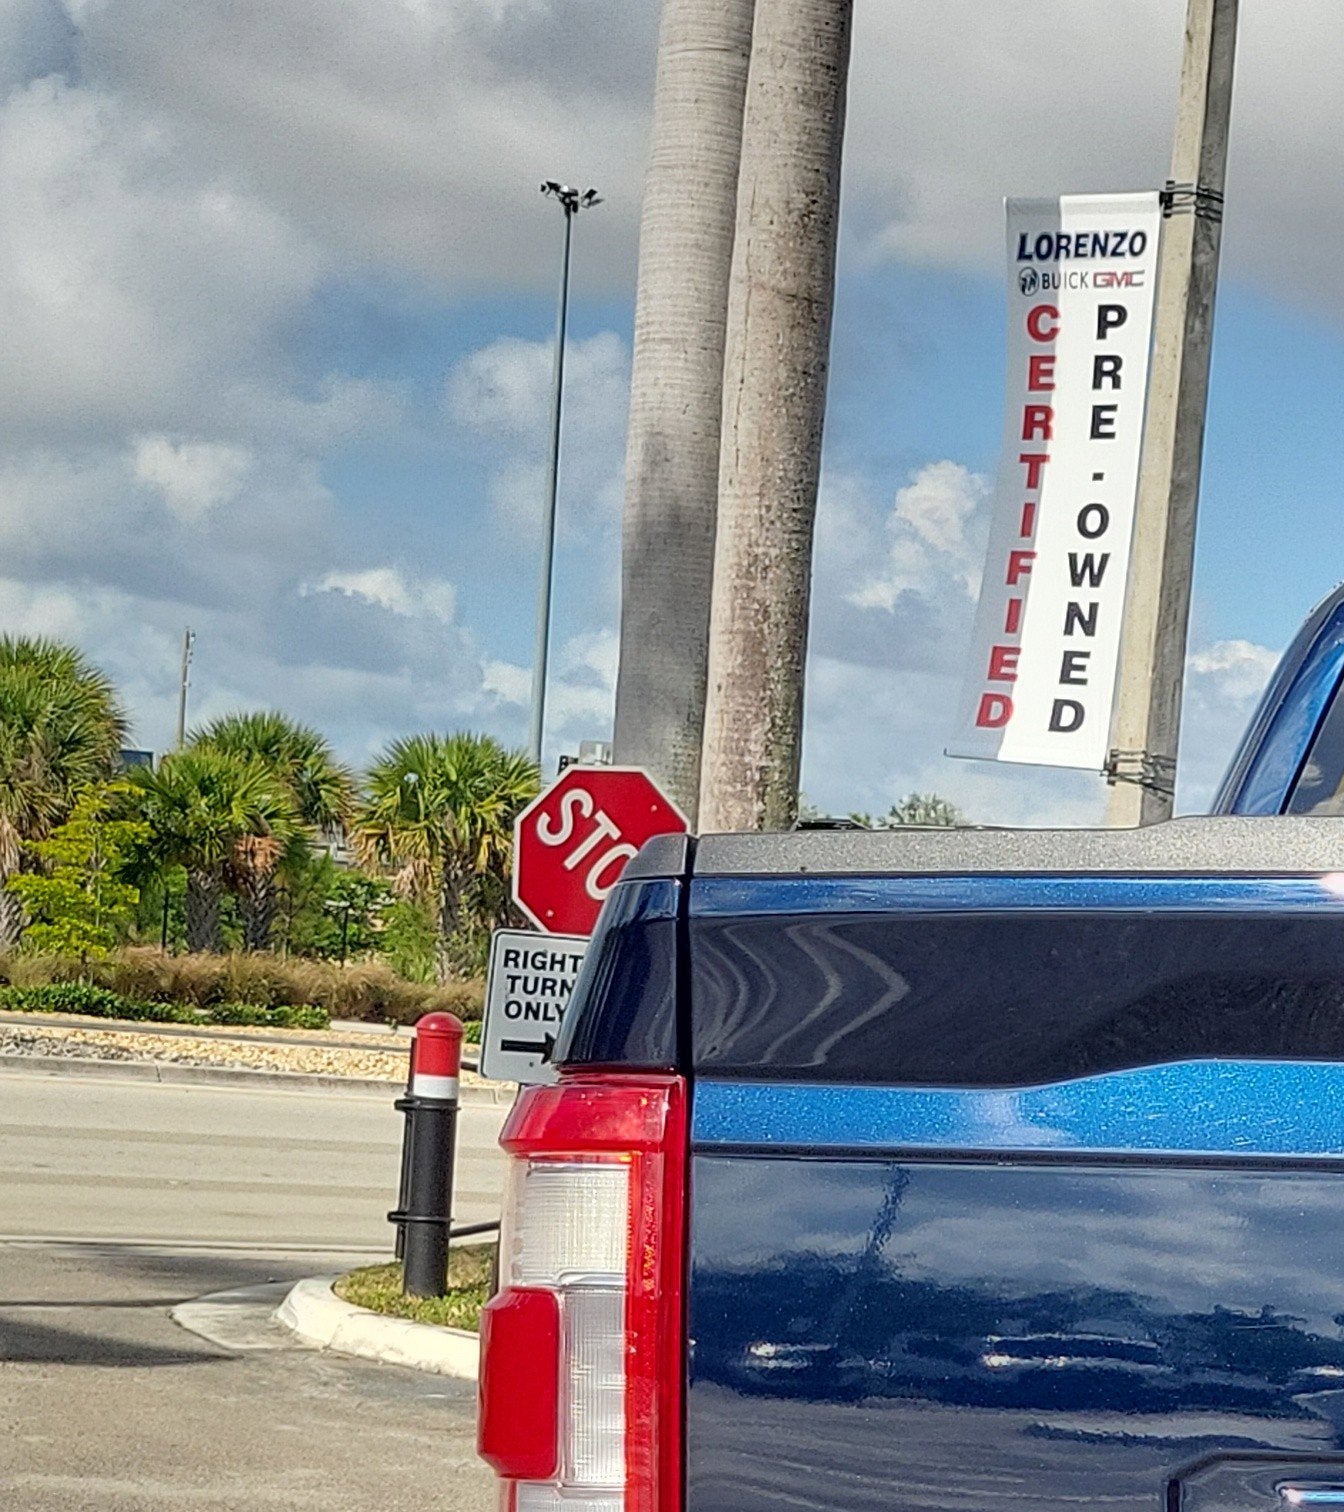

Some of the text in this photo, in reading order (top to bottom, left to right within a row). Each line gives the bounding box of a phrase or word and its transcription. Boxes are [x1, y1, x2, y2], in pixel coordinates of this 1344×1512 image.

[1016, 230, 1148, 262] LORENZO
[1041, 269, 1146, 290] BUICK GMC
[975, 304, 1061, 729] CERTIFIED
[537, 788, 639, 901] STO
[503, 949, 585, 974] RIGHT
[506, 974, 574, 997] TURN
[504, 999, 567, 1022] ONLY
